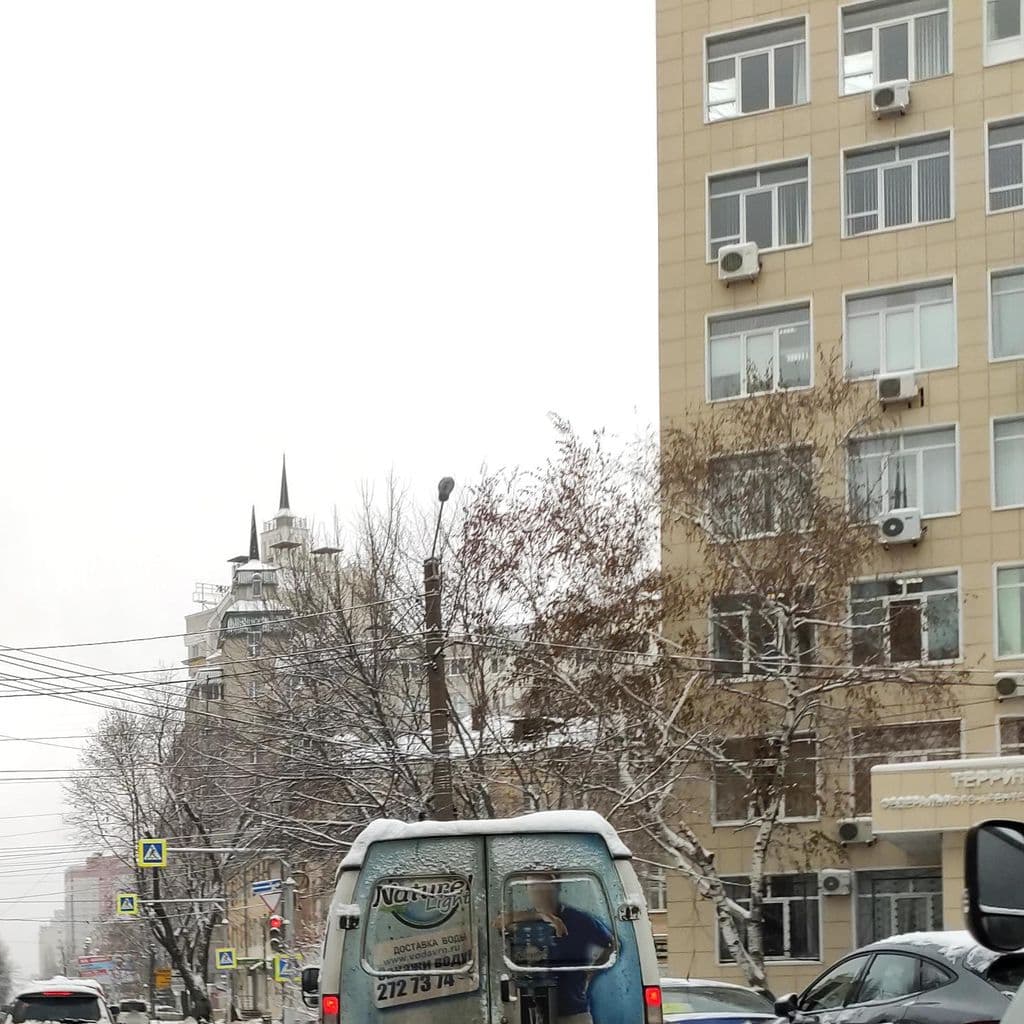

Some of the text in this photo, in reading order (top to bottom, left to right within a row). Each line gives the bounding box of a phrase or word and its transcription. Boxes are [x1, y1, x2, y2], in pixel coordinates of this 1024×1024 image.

[426, 890, 472, 914] Light
[393, 932, 467, 955] ДОСТАВКА ВОДЫ
[377, 974, 455, 1001] 272 73 74
